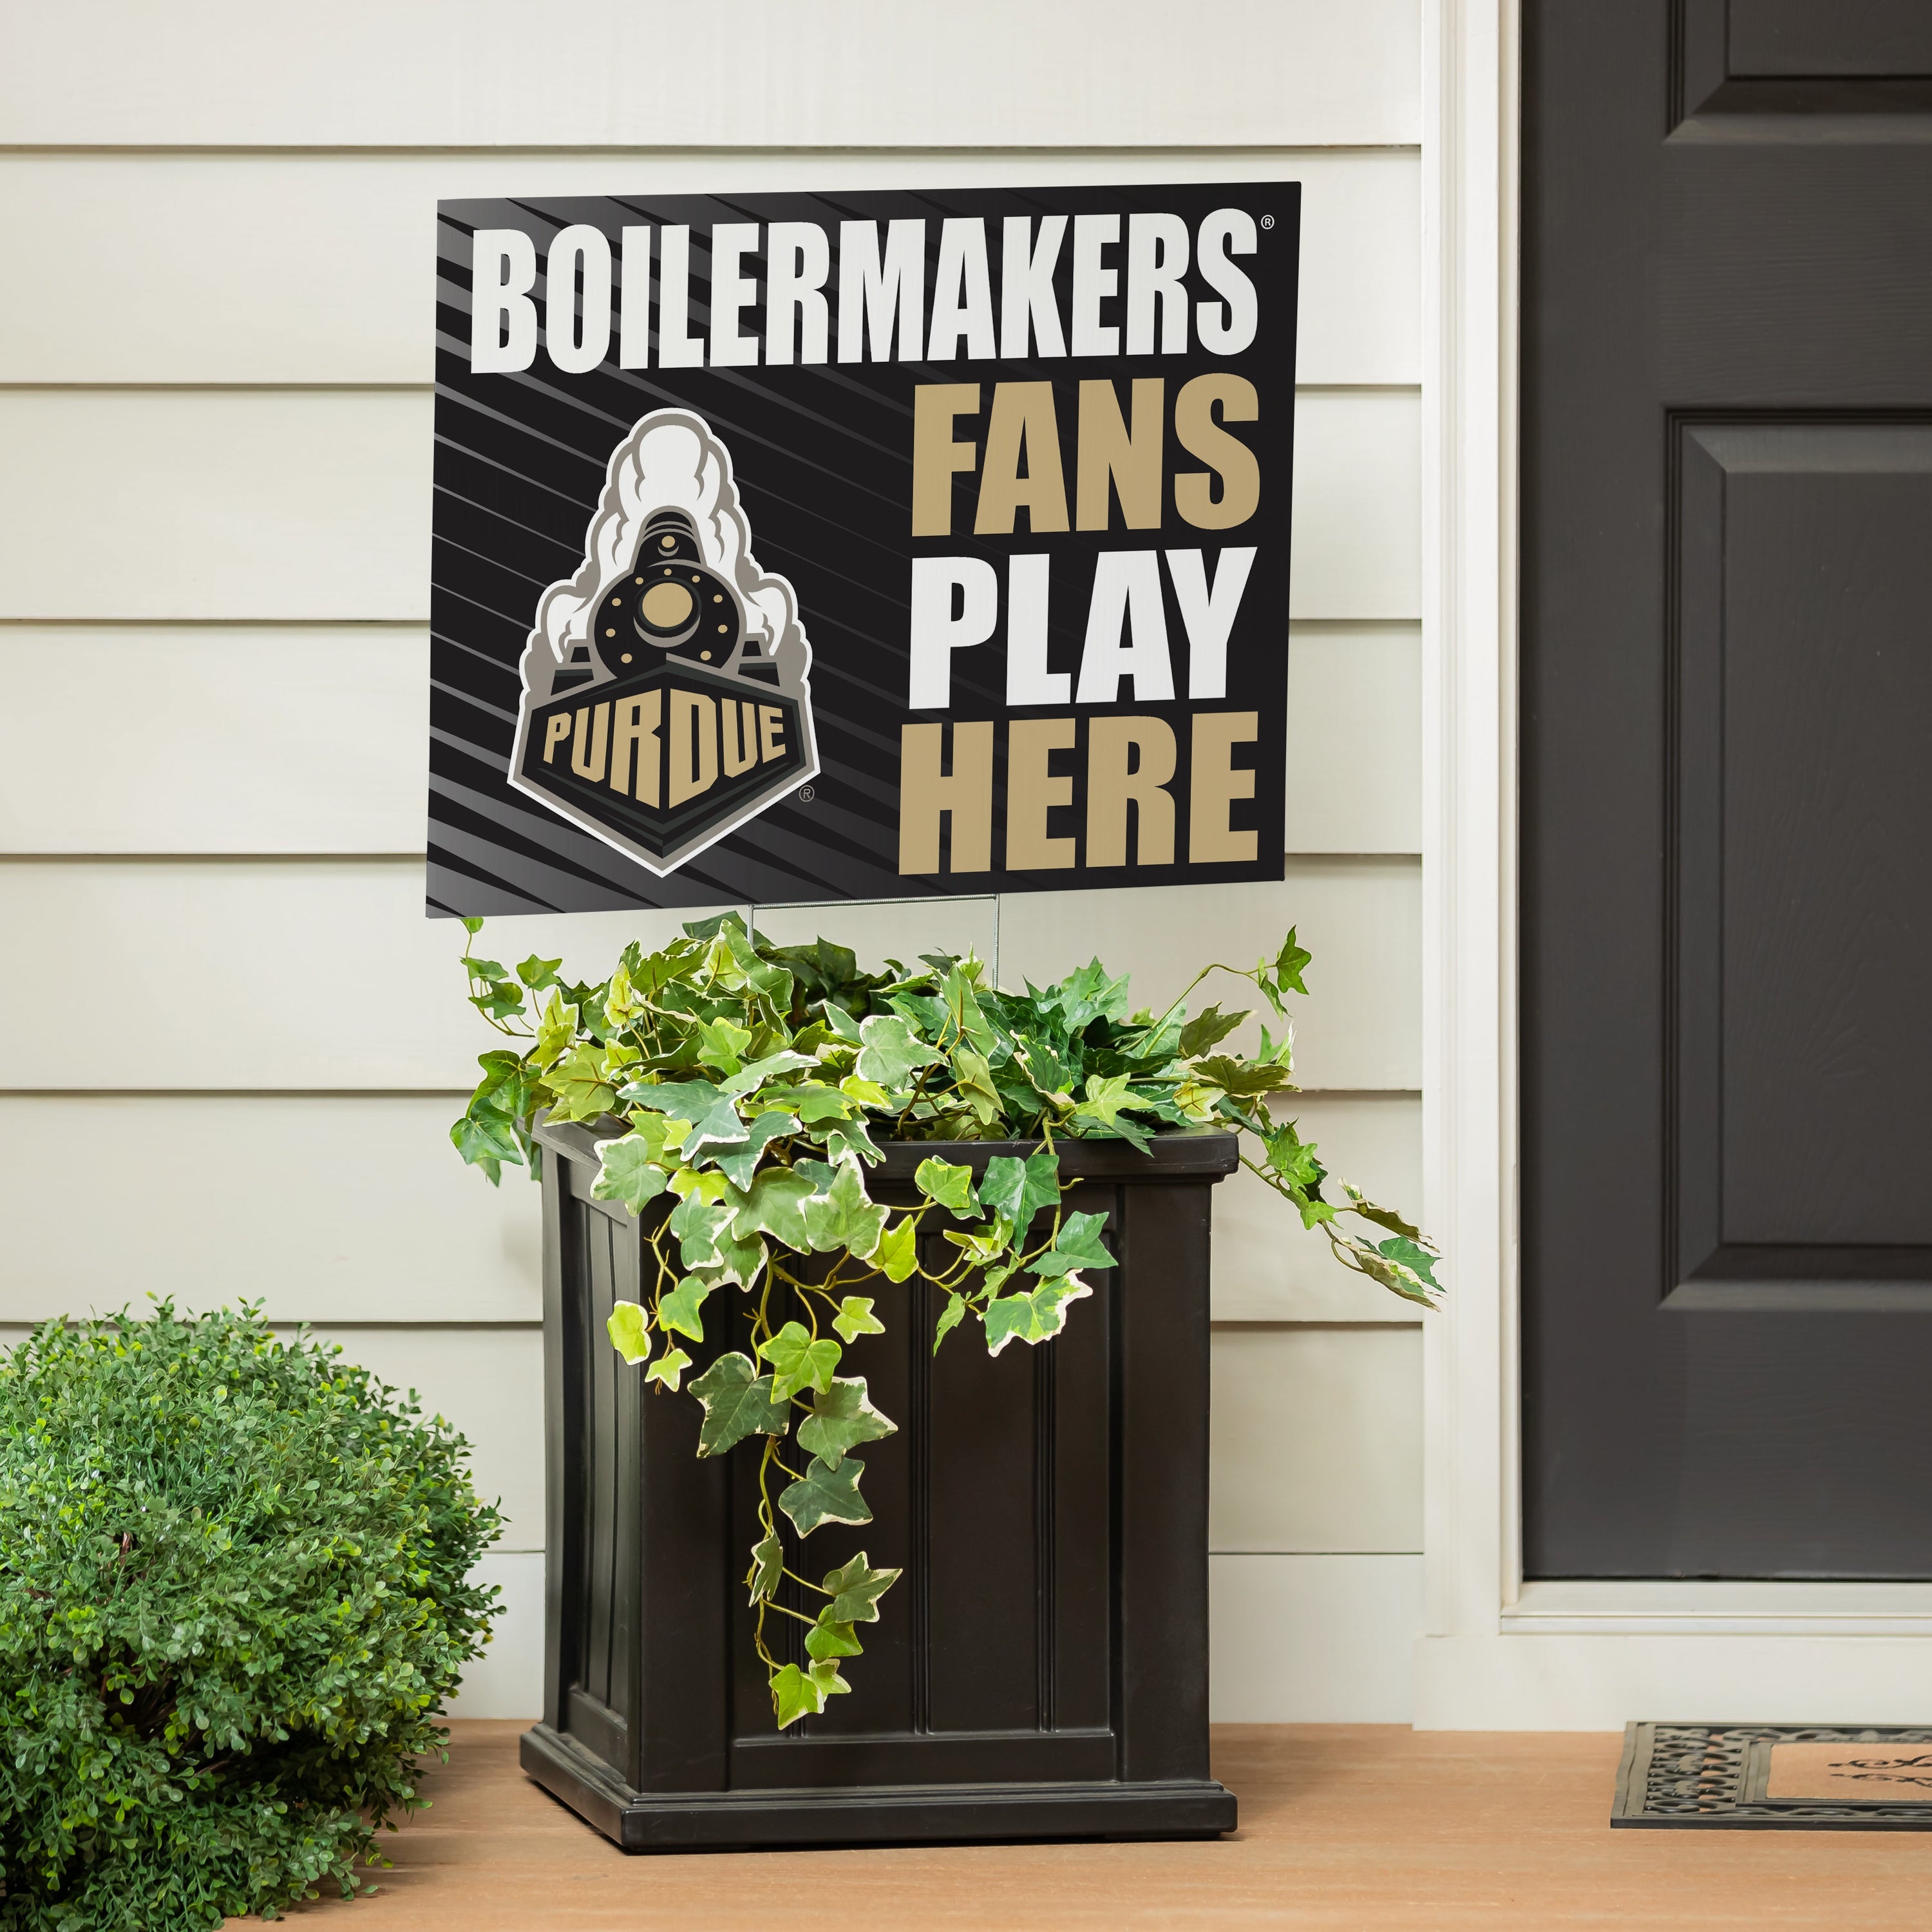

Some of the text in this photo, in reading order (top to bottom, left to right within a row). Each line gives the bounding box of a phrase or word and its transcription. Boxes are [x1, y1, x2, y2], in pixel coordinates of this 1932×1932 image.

[912, 373, 1260, 536] FANS
[909, 547, 1258, 710] PLAY
[543, 688, 786, 810] PURDUE
[898, 711, 1258, 875] HERE
